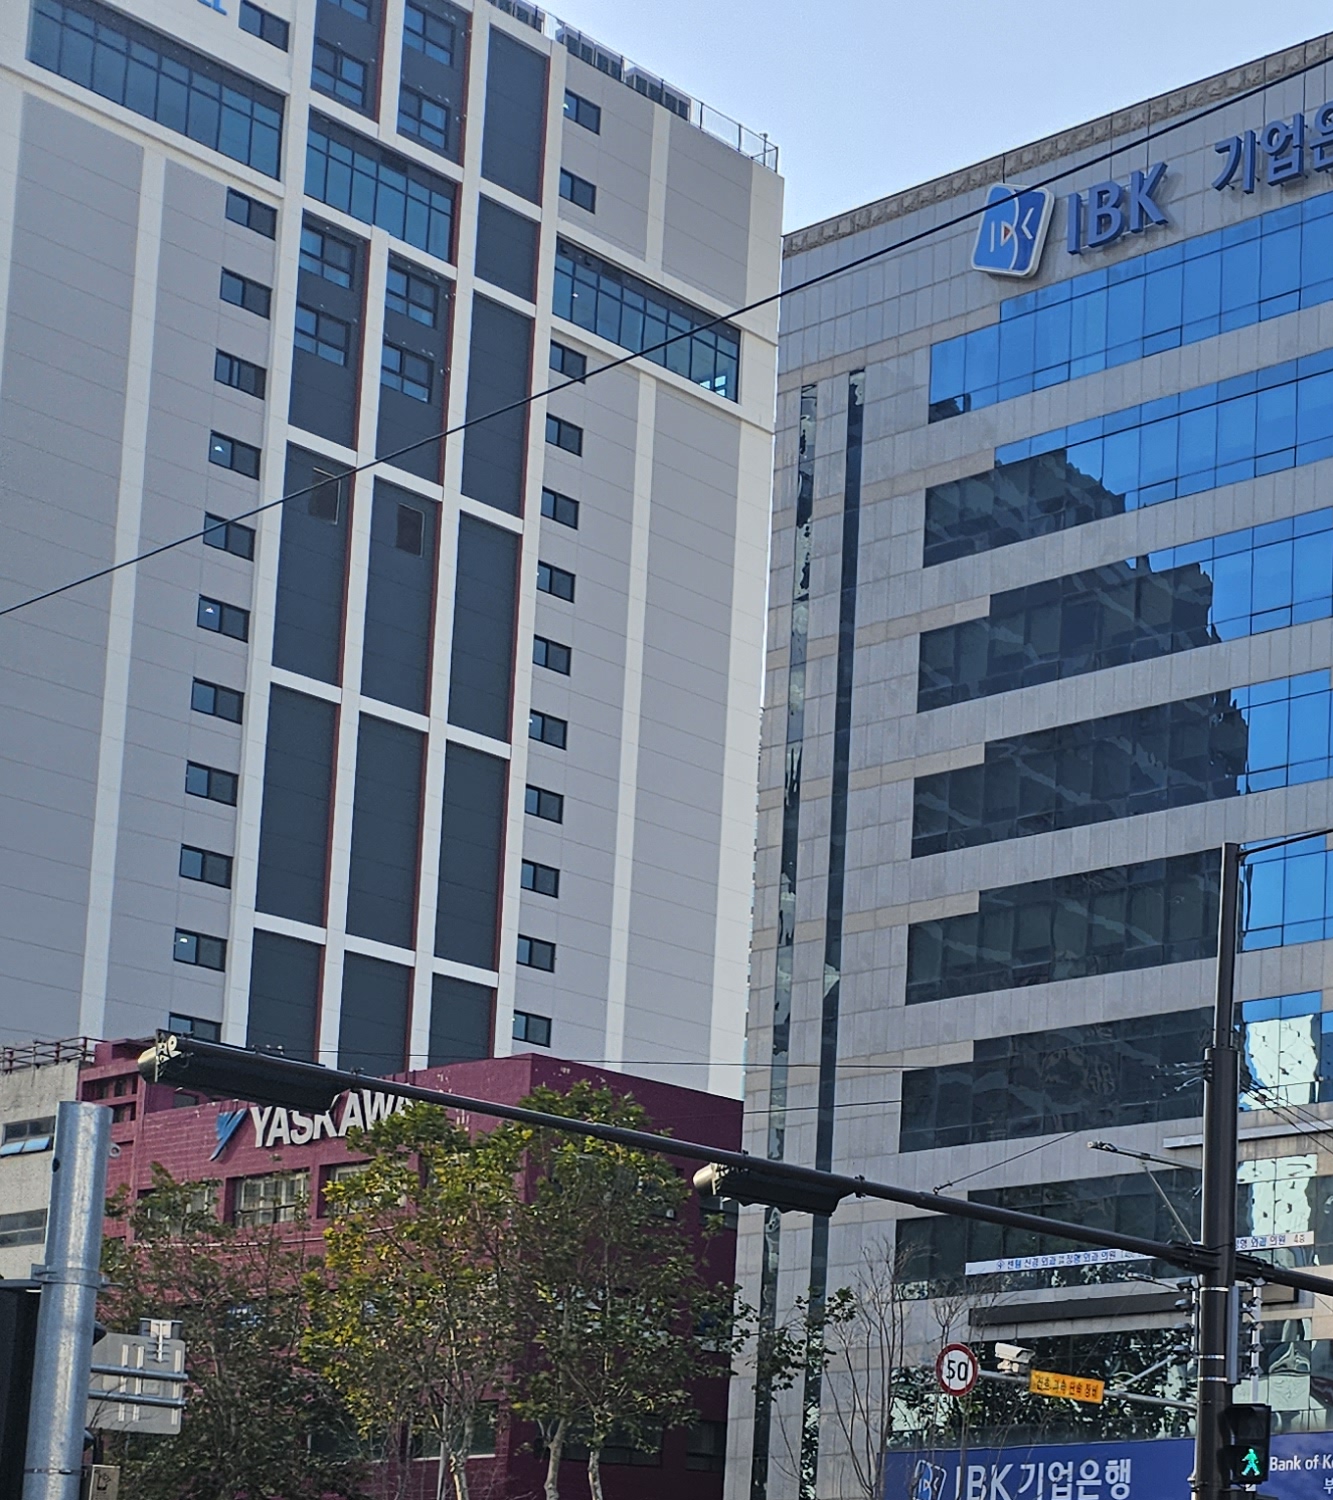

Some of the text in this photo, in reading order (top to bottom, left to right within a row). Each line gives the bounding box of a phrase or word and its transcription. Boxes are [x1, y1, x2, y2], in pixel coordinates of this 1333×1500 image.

[1066, 162, 1171, 255] IBK
[945, 1359, 969, 1384] 50
[1268, 1455, 1302, 1471] Bank
[1304, 1454, 1320, 1471] of
